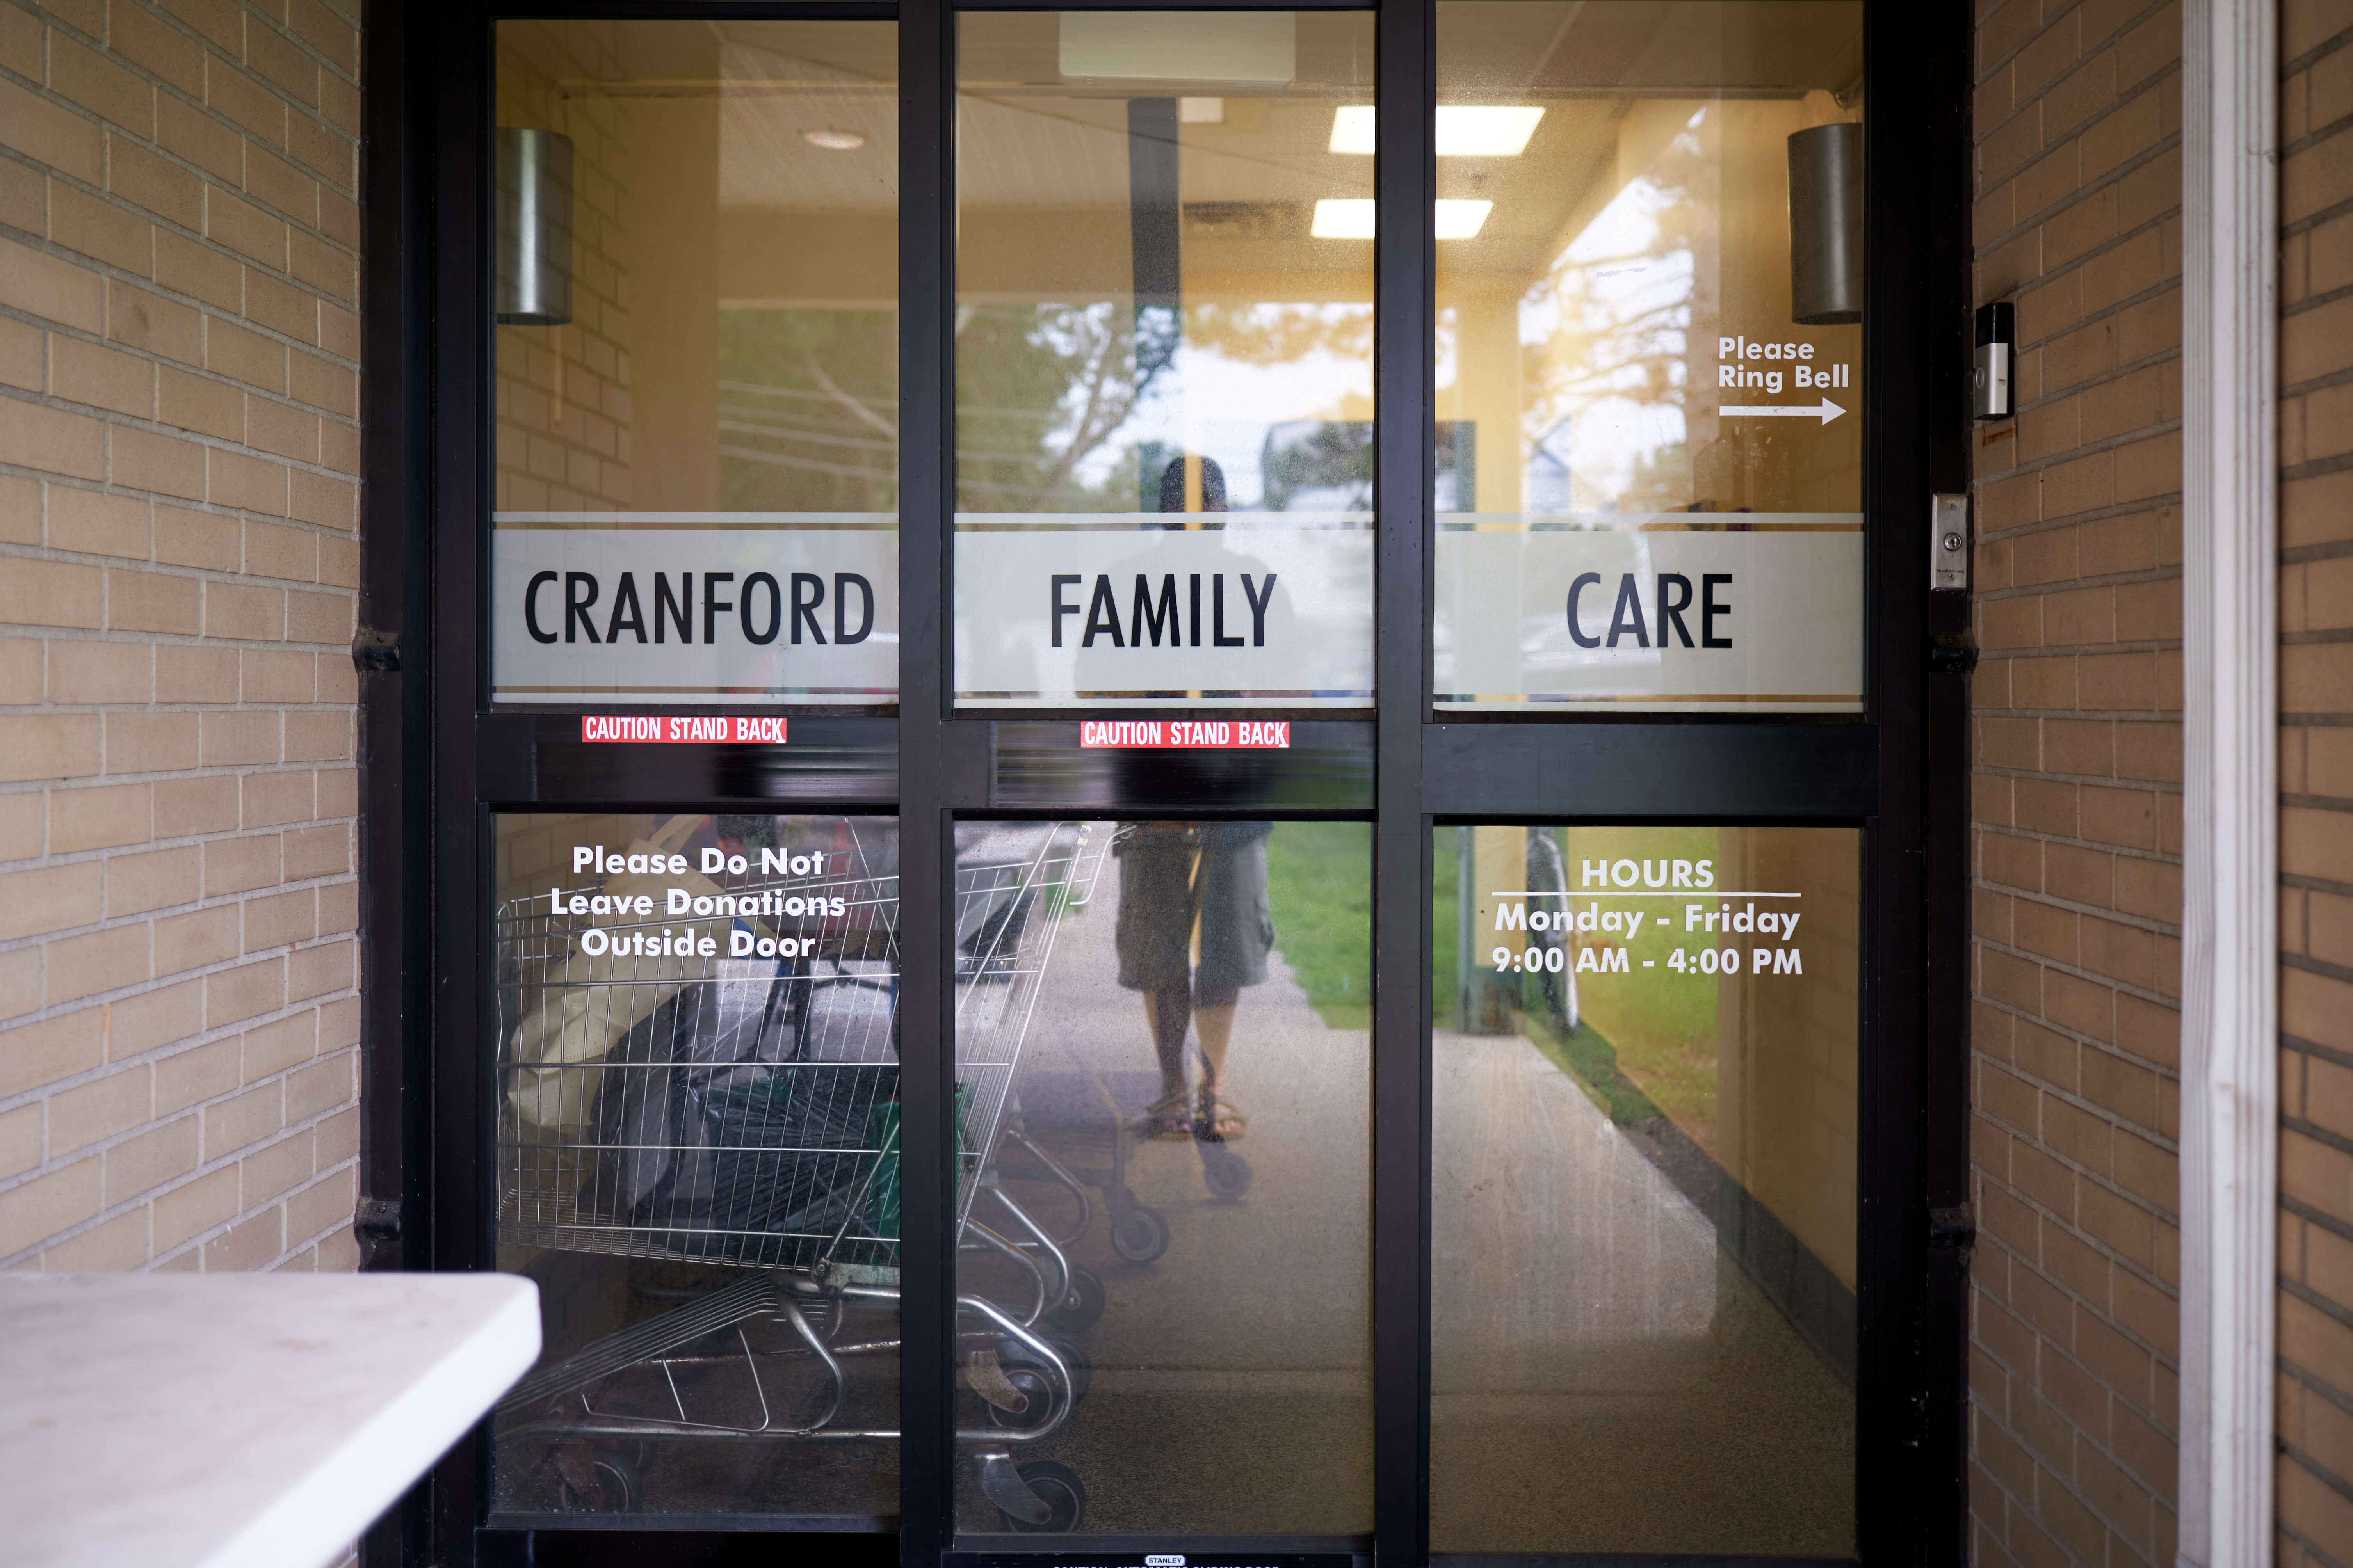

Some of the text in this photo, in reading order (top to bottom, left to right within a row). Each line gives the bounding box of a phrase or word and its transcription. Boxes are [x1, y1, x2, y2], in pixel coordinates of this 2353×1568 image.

[1719, 336, 1814, 359] Please
[1719, 364, 1848, 393] Ring Bell
[525, 571, 1732, 648] CRANFORD FAMILY CARE
[586, 717, 783, 740] CAUTION STAND BACK
[1085, 722, 1286, 745] CAUTION STAND BACK
[573, 845, 824, 875] Please Do Not
[1582, 859, 1714, 888] HOURS
[552, 888, 845, 917] Leave Donations
[1495, 902, 1644, 939] Monday
[1685, 903, 1801, 940] Friday
[581, 928, 816, 957] Outside Door
[1492, 947, 1564, 973] 9:00
[1575, 947, 1629, 973] AM
[1667, 948, 1740, 974] 4:00
[1753, 949, 1802, 974] PM
